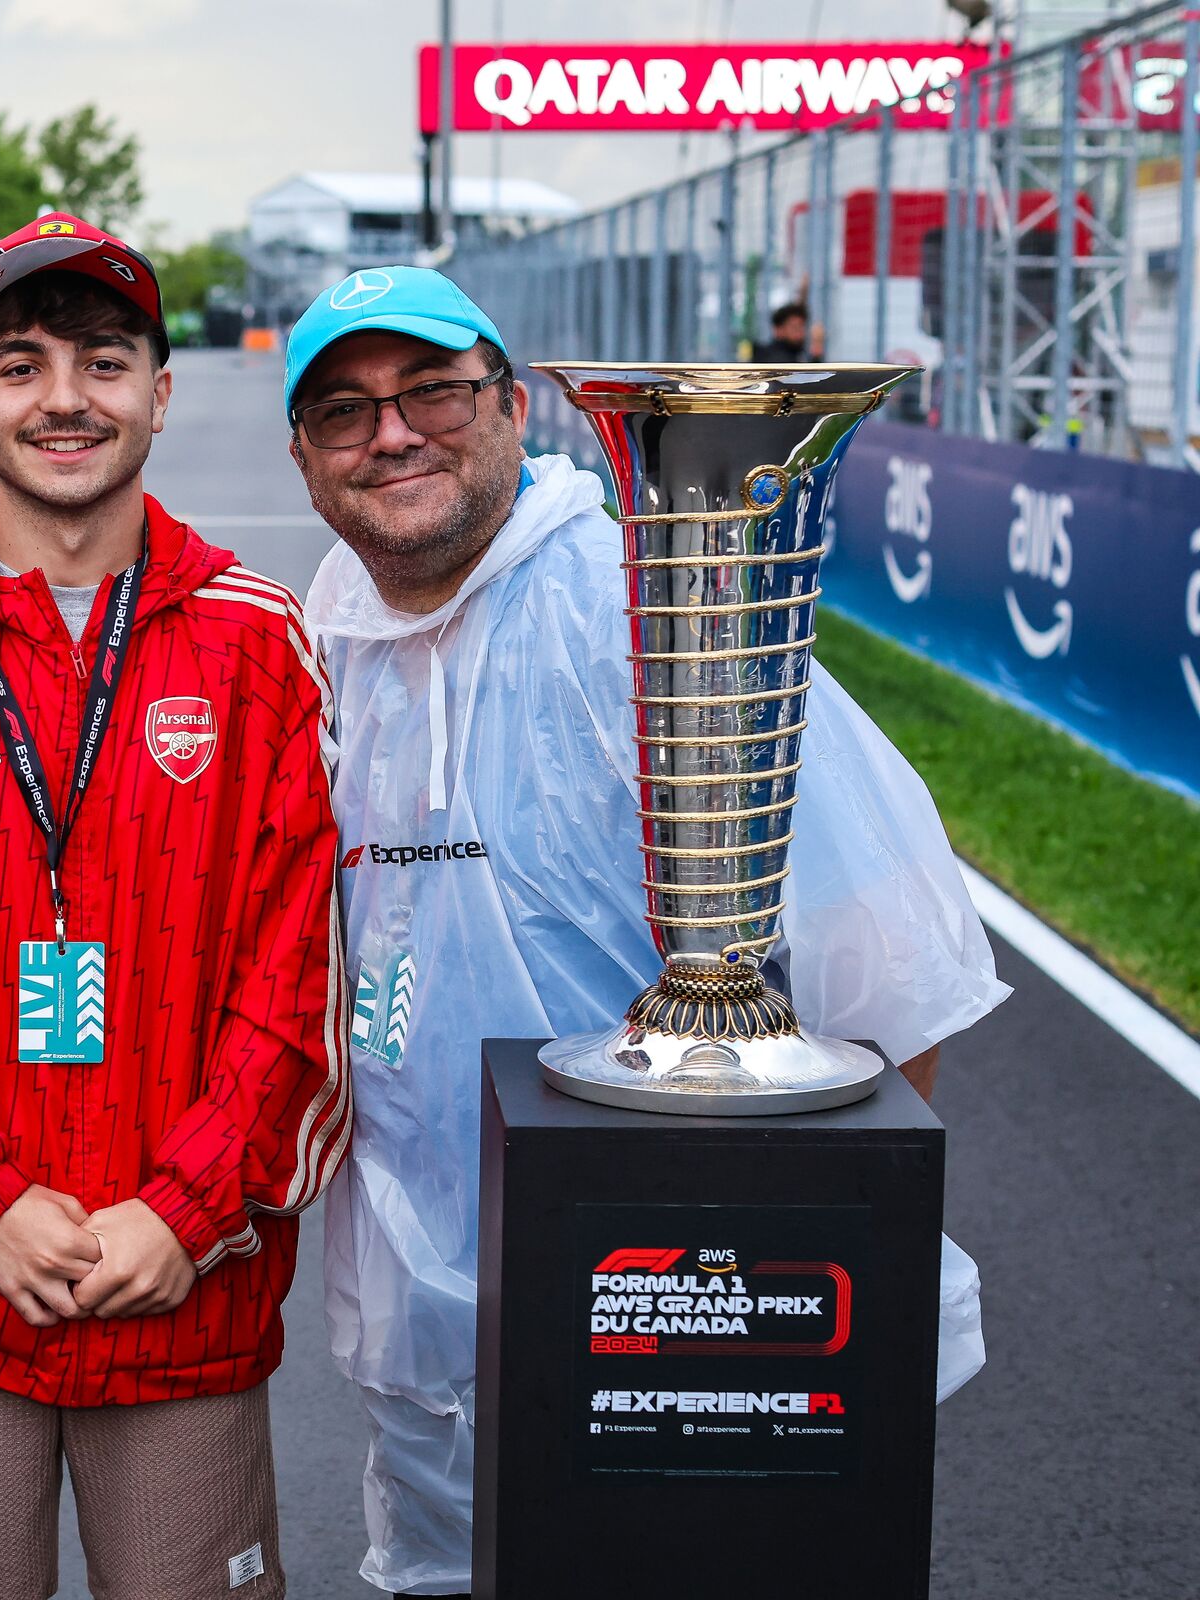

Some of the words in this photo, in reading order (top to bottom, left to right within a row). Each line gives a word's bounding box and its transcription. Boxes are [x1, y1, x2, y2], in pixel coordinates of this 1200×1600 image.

[474, 58, 689, 125] QATAR
[697, 57, 963, 114] AIRWAYS
[1007, 483, 1074, 589] aws
[155, 711, 210, 726] Arsenal
[77, 697, 107, 789] Experiences
[15, 744, 53, 833] Experiences
[698, 1249, 736, 1263] aws
[592, 1274, 726, 1293] FORMULA
[731, 1275, 746, 1293] 1
[591, 1295, 653, 1313] AWS
[657, 1296, 753, 1314] GRAND
[757, 1296, 823, 1315] PRIX
[591, 1316, 628, 1333] DU
[632, 1316, 748, 1335] CANADA
[591, 1336, 658, 1353] 2024
[590, 1390, 845, 1414] #EXPERIENCEF1
[614, 1424, 657, 1433] Experiences
